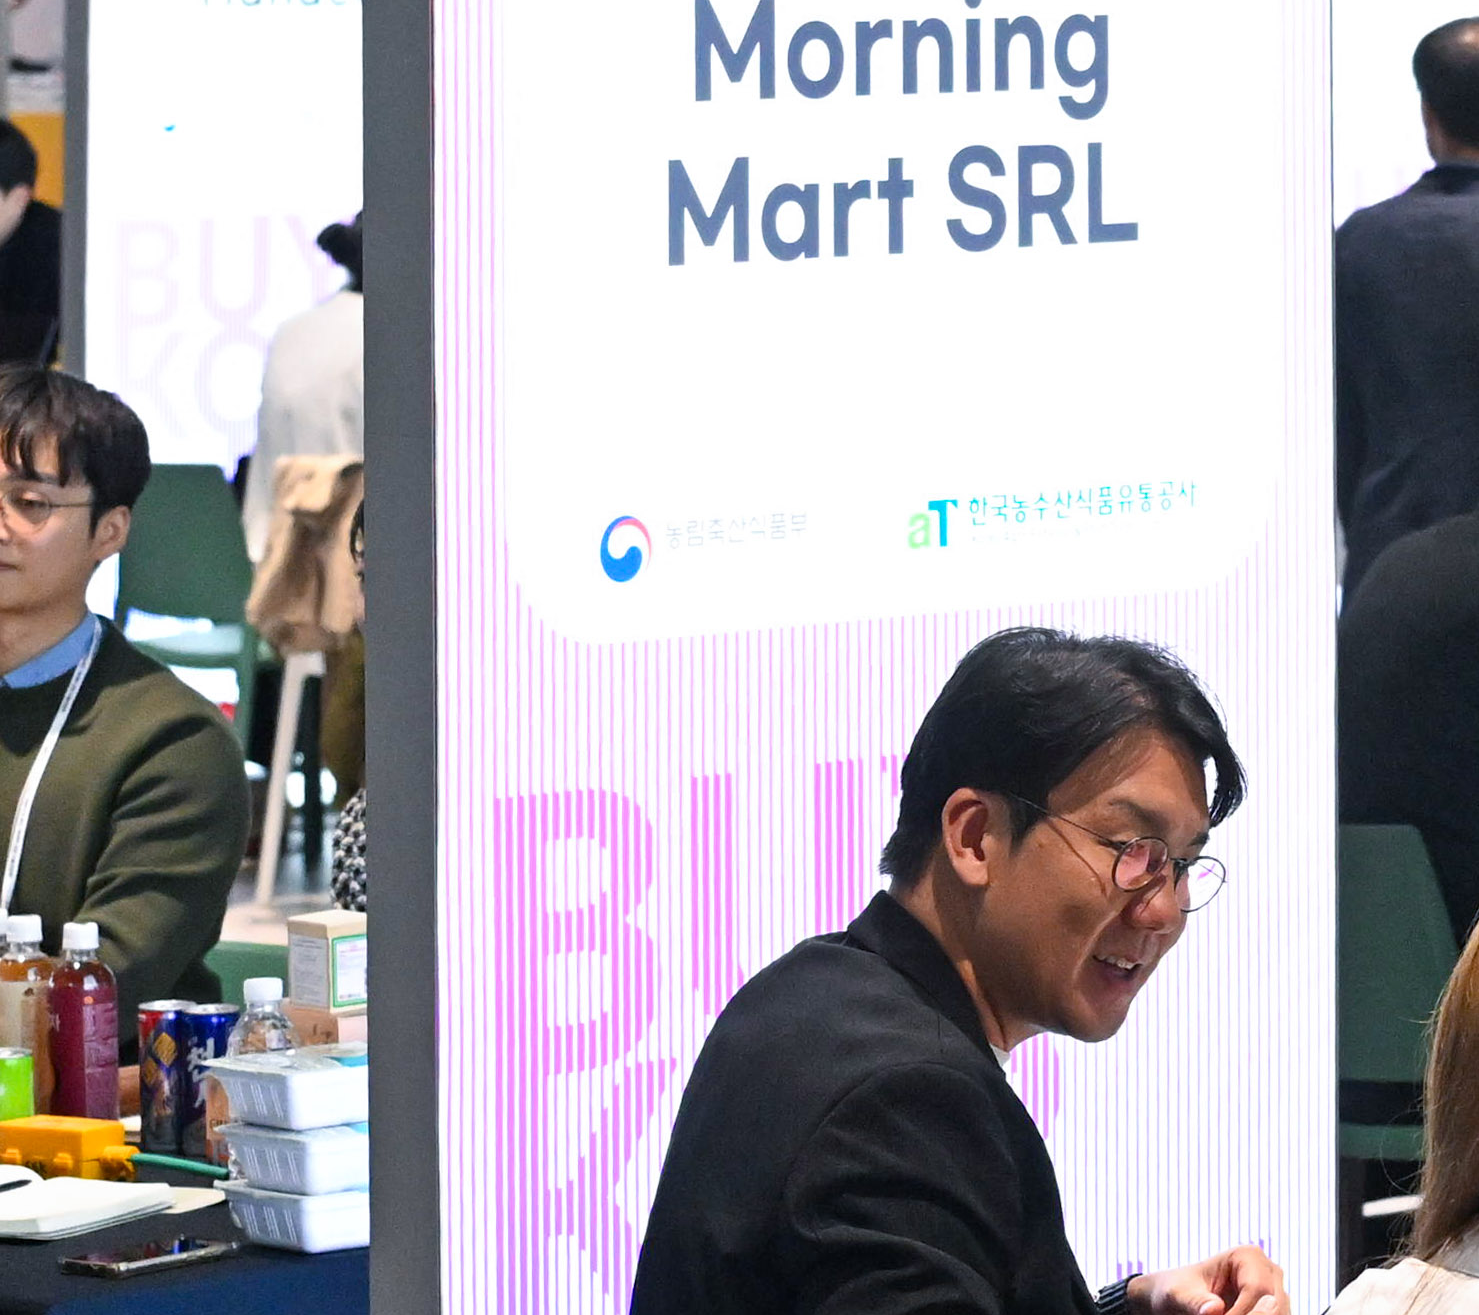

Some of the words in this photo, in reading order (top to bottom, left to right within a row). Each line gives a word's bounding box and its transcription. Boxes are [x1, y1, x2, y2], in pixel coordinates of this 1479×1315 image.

[666, 156, 915, 267] Mart
[945, 141, 1139, 252] SRL
[907, 498, 958, 549] aT
[969, 479, 1199, 526] 한국농수산식품유통공사
